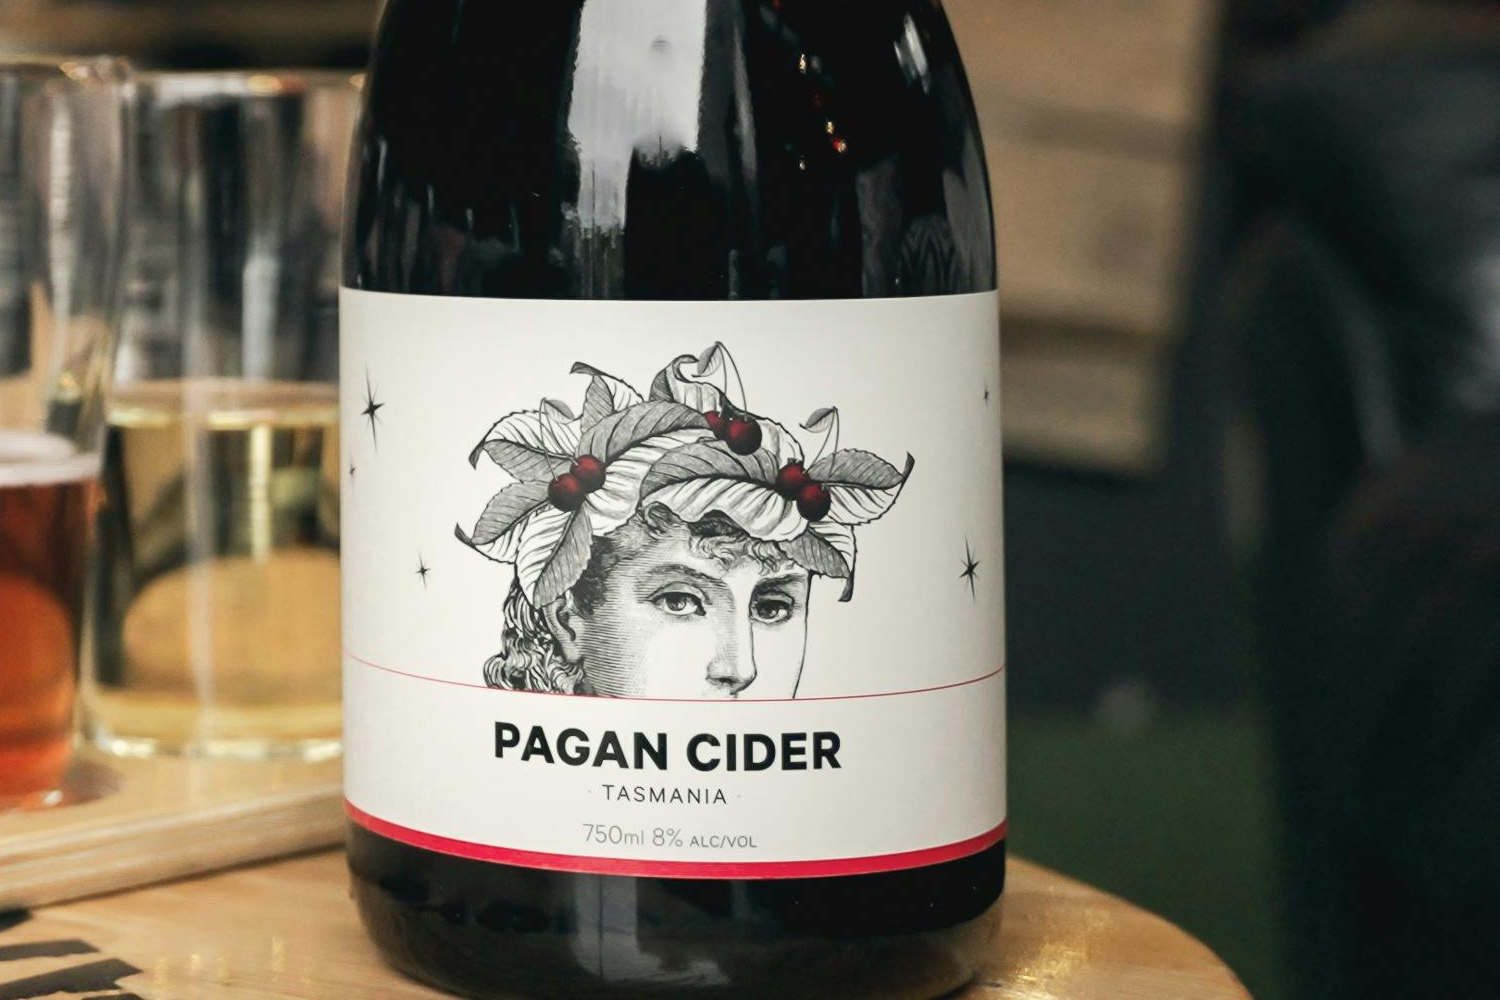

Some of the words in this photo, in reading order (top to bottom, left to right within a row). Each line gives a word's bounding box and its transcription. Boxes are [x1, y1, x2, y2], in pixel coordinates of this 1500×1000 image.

[493, 721, 669, 770] PAGAN
[686, 730, 842, 772] CIDER
[601, 783, 728, 805] TASMANIA
[582, 823, 645, 846] 750ml
[651, 827, 684, 848] 8%
[688, 834, 758, 849] ALC/VOL
